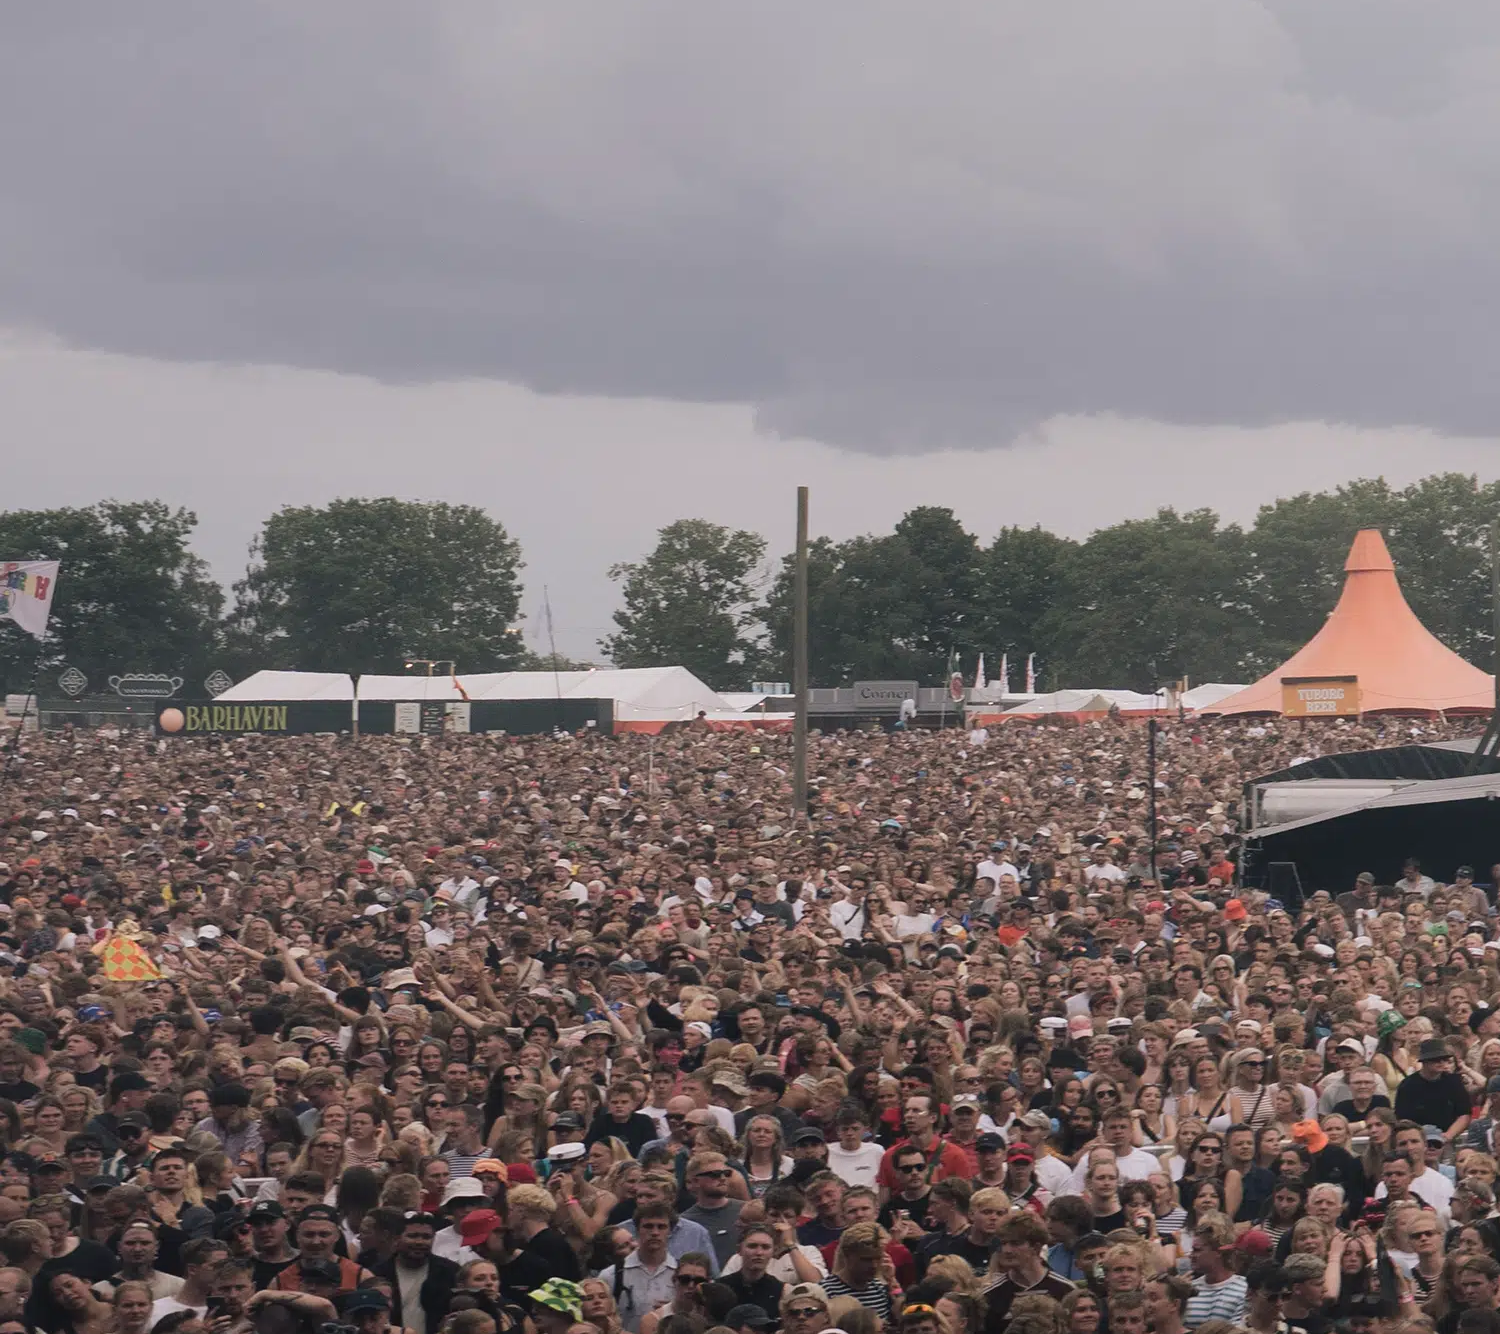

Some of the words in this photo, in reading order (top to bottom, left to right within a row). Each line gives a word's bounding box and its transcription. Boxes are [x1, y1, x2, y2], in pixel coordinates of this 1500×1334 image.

[859, 687, 911, 700] Corner
[1298, 688, 1345, 701] TUBORG
[1305, 701, 1337, 713] BEER
[185, 705, 288, 731] BARHAVEN
